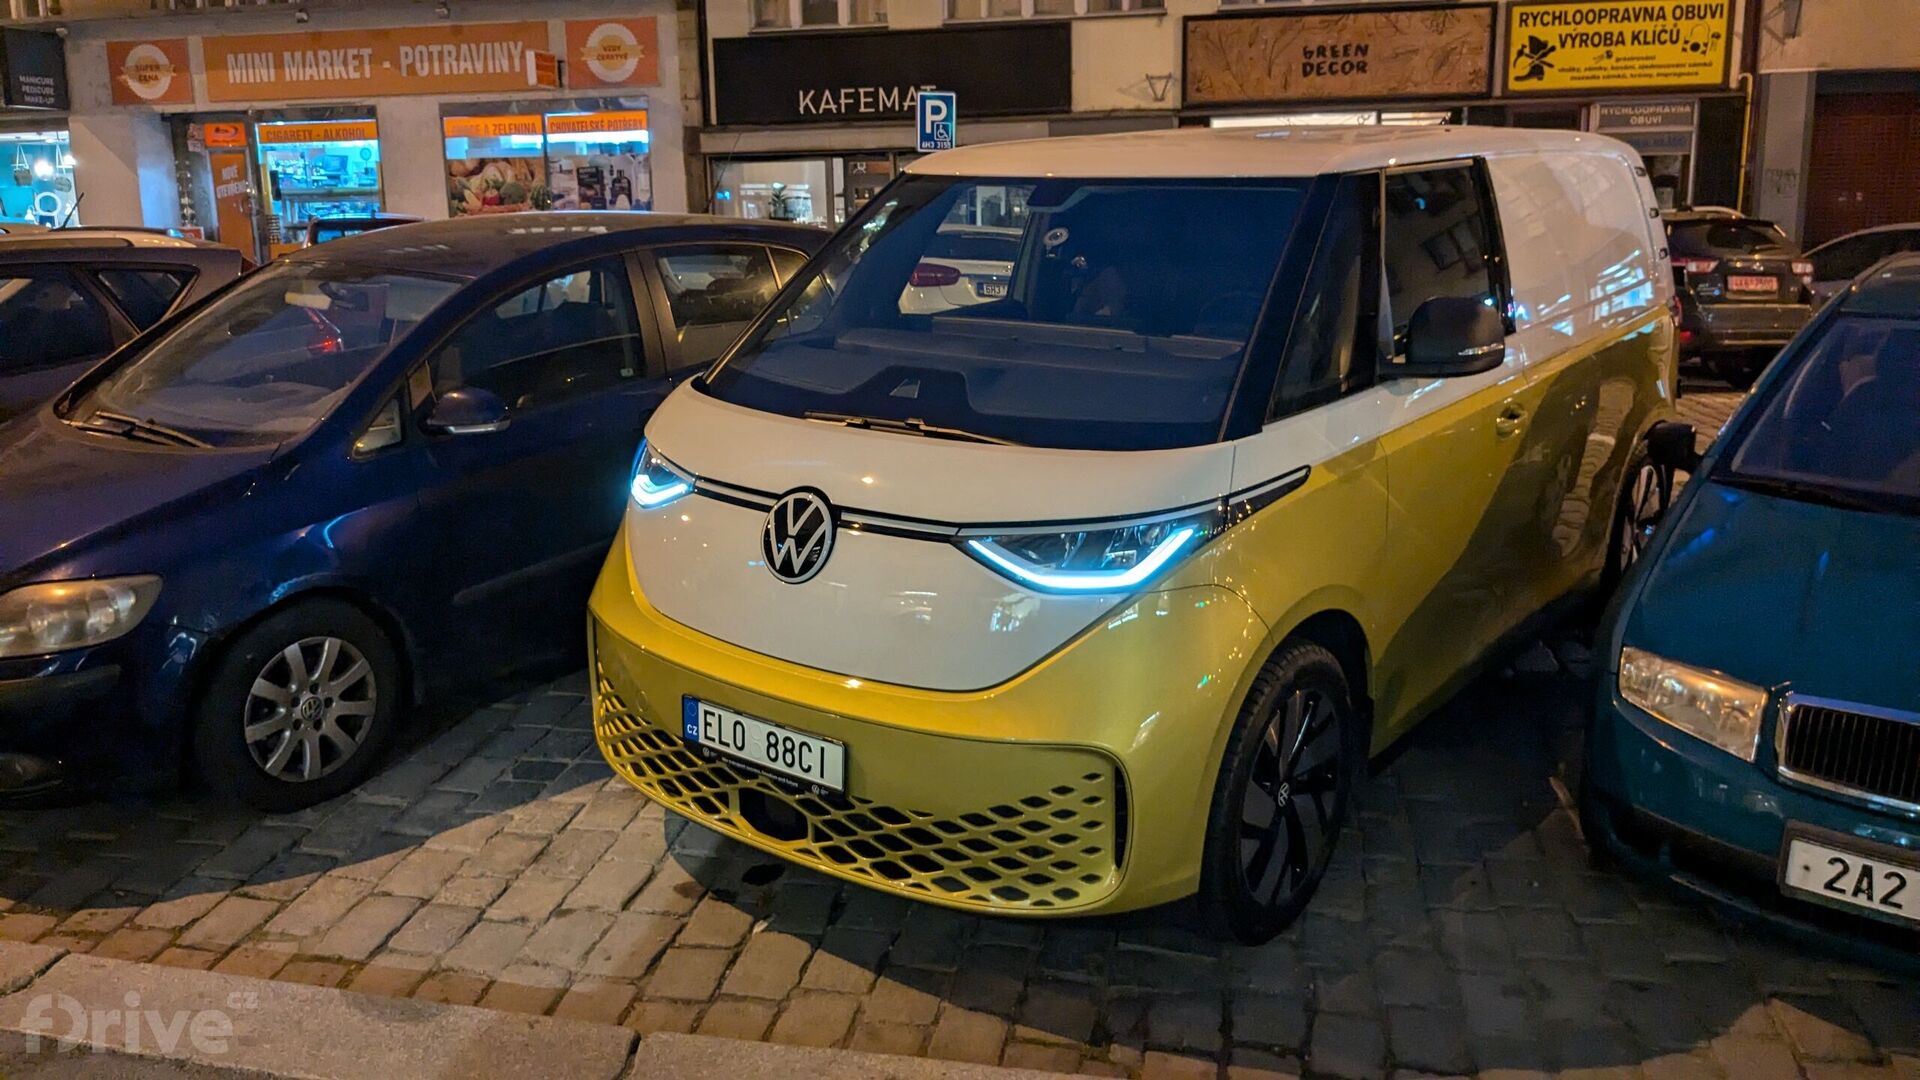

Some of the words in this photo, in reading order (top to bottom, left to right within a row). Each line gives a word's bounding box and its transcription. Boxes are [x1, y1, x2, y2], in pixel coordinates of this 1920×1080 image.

[1519, 8, 1666, 27] RYCHLOOPRAVNA
[1672, 4, 1724, 21] OBUVI
[1558, 28, 1625, 48] VÝROBA
[1631, 23, 1681, 46] KLÍČŮ
[1302, 43, 1369, 59] GREEN
[227, 52, 276, 84] MINI
[283, 47, 373, 82] MARKET
[400, 41, 523, 77] POTRAVINY
[1302, 60, 1368, 78] DECOR
[19, 75, 54, 85] MANICURE
[21, 85, 54, 95] PEDICURE
[24, 94, 55, 104] MAKE-UP
[799, 85, 936, 114] KAFEMA
[925, 99, 948, 134] P
[1601, 104, 1691, 115] RYCHLOOPRAVNA
[550, 119, 605, 132] CHOVATELSKÉ
[1629, 116, 1662, 125] OBUVI
[266, 129, 313, 141] CIGARETY
[323, 127, 365, 139] ALKOHOL
[492, 123, 537, 135] ZELENINA
[687, 724, 698, 736] CZ
[766, 731, 825, 779] 88CI
[1823, 857, 1903, 909] 2A2
